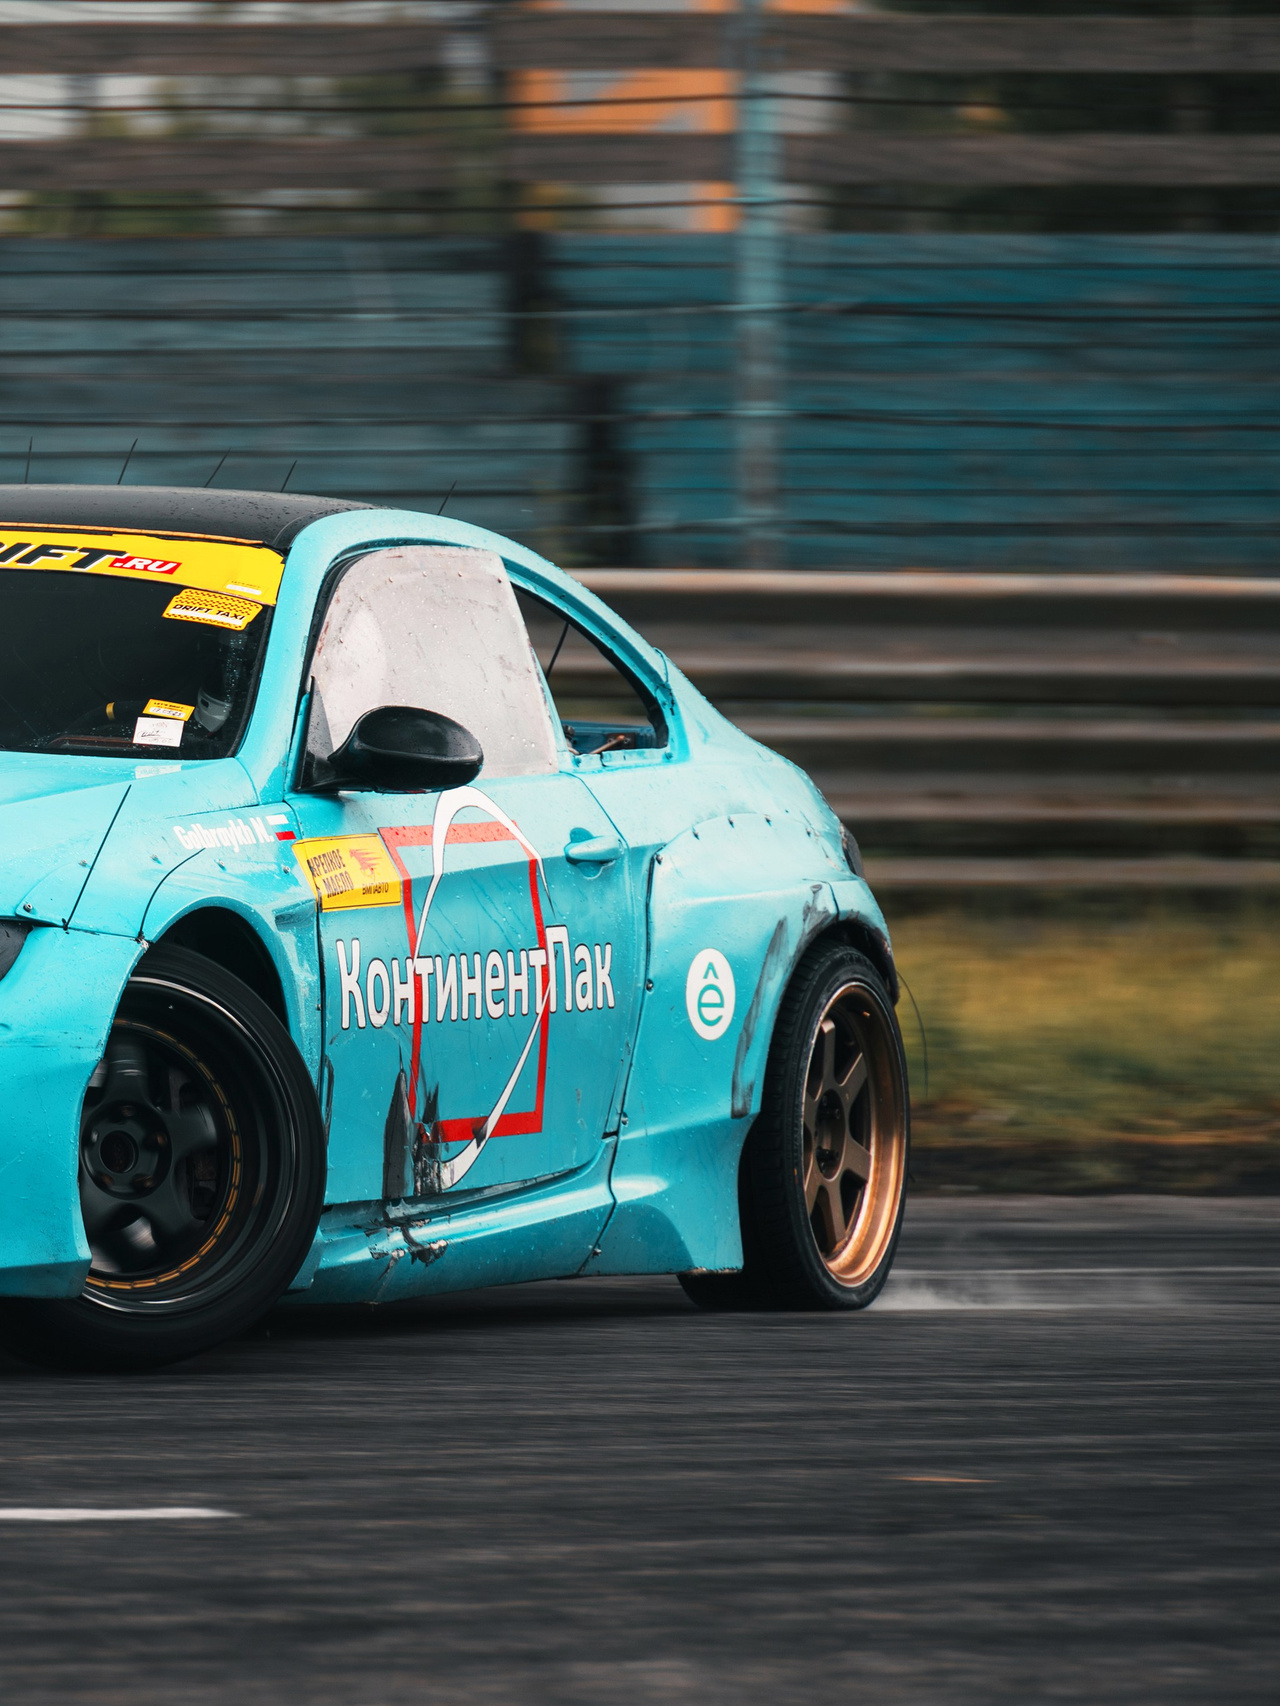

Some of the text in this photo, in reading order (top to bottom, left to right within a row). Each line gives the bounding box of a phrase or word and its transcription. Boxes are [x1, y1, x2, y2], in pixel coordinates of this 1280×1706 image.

[173, 604, 245, 621] DRIFT TAXI
[173, 818, 256, 853] Golbraykh
[306, 849, 346, 877] КРЕПКОЕ
[322, 870, 354, 898] МАСЛО
[336, 925, 616, 1030] КонтинентПак
